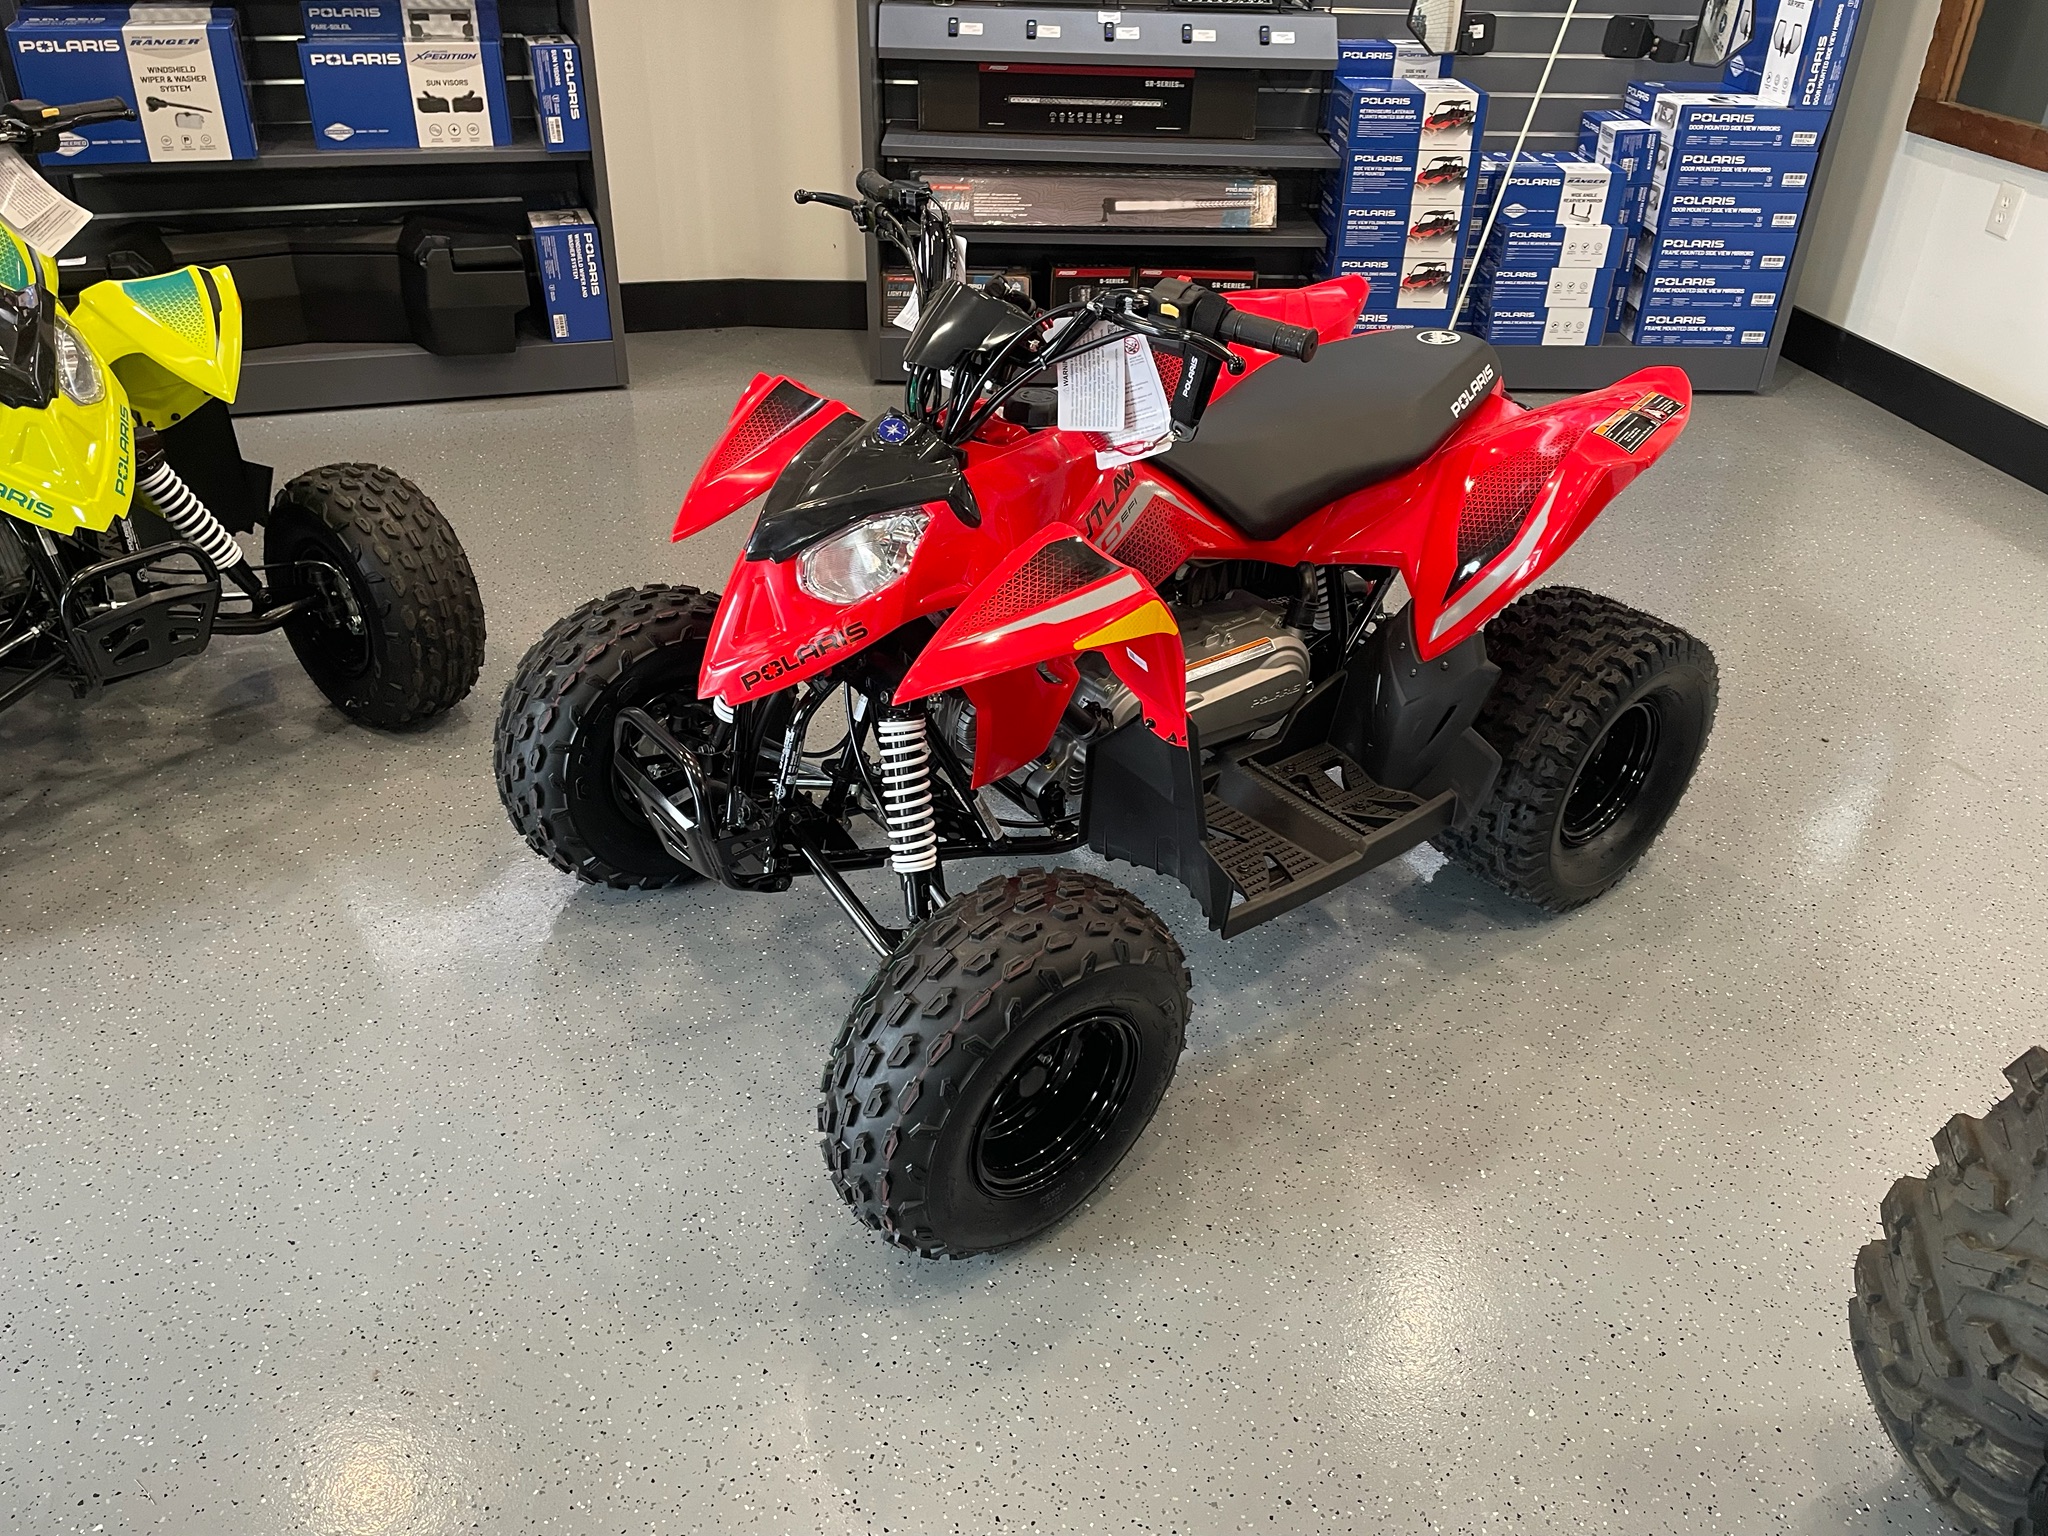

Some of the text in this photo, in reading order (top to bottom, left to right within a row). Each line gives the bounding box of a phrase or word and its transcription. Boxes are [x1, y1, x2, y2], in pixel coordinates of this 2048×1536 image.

[307, 7, 381, 18] POLARIS
[18, 39, 120, 53] POLARIS
[130, 38, 202, 46] RANGER
[310, 53, 402, 66] POLARIS
[410, 50, 478, 63] XPEDITION
[1342, 51, 1393, 59] POLARIS
[146, 65, 196, 74] WINDSHIELD
[1802, 35, 1828, 106] POLARIS
[140, 75, 166, 84] WIPER
[174, 75, 207, 83] WASHER
[425, 79, 442, 87] SUN
[562, 48, 580, 120] POLARIS
[1626, 86, 1650, 102] POLARIS
[1360, 97, 1411, 105] POLARIS
[1690, 113, 1755, 123] POLARIS
[1354, 155, 1403, 163] POLARIS
[1682, 155, 1746, 164] POLARIS
[1508, 178, 1561, 186] POLARIS
[1673, 196, 1736, 205] POLARIS
[930, 201, 951, 210] LIHT
[953, 201, 970, 211] BAR
[1348, 209, 1396, 217] POLARIS
[1662, 239, 1725, 249] POLARIS
[583, 232, 600, 296] POLARIS
[1654, 277, 1716, 287] POLARIS
[1358, 314, 1388, 322] ARIS
[1645, 315, 1707, 325] POLARIS
[1182, 356, 1198, 398] POLARIS
[1450, 363, 1494, 419] POLARIS
[115, 404, 130, 497] POLARIS
[0, 482, 55, 519] ARIS
[1085, 463, 1136, 540] TLAW
[1120, 498, 1138, 523] EFI
[740, 621, 869, 692] POLARIS
